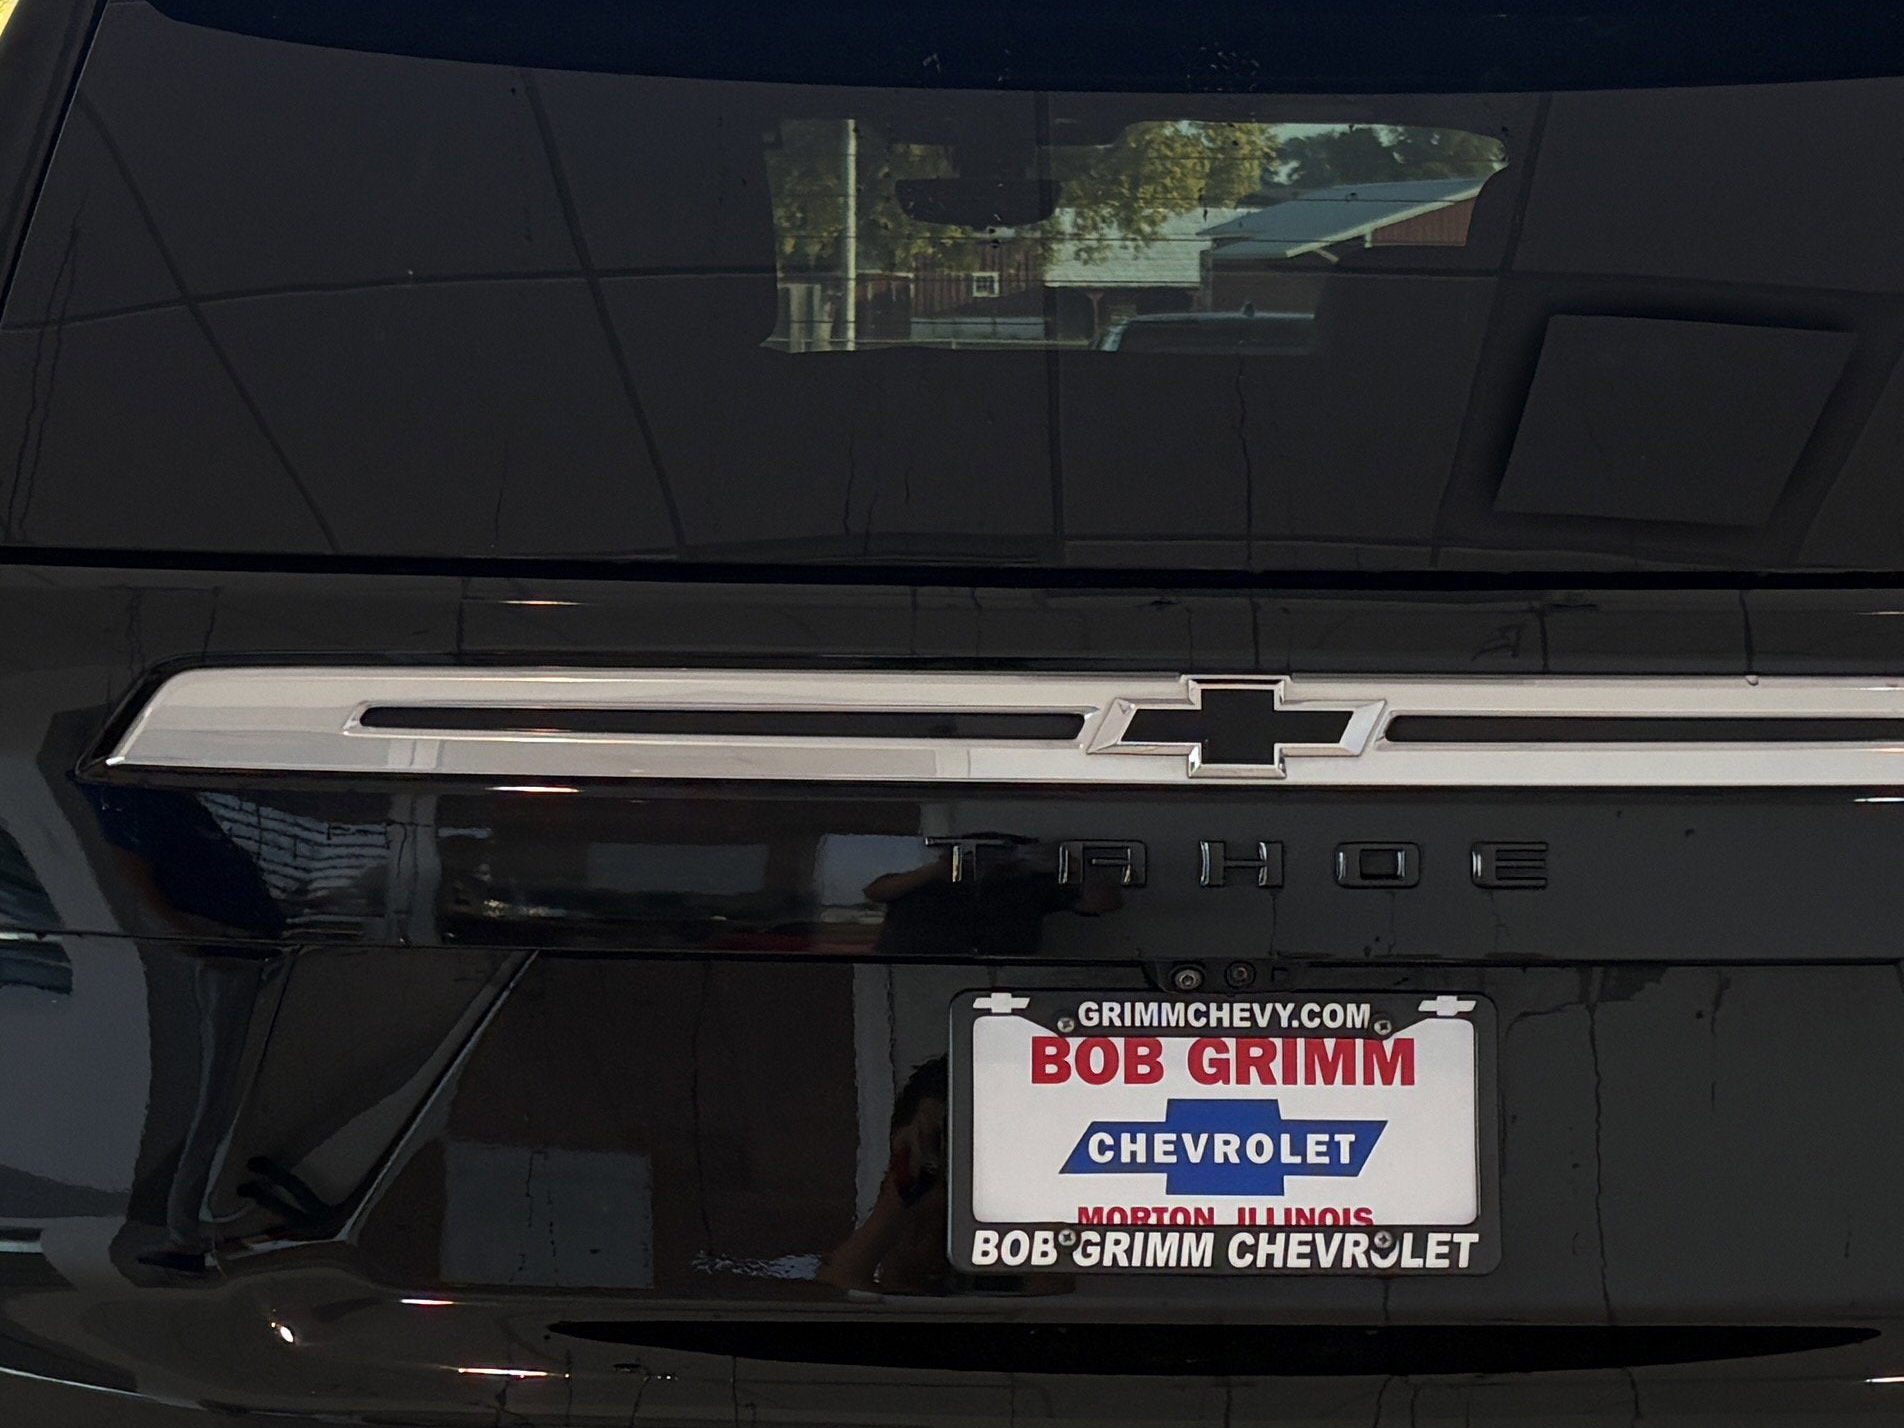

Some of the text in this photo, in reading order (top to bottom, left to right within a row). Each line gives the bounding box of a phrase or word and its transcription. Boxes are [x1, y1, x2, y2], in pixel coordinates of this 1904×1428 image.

[924, 835, 1549, 890] TAHOE
[1077, 1000, 1371, 1030] GRIMMCHEVY.COM
[1030, 1036, 1416, 1087] BOB GRIMM
[1087, 1132, 1357, 1165] CHEVROLET
[971, 1230, 1058, 1267] BOB
[1072, 1230, 1214, 1269] GRIMM
